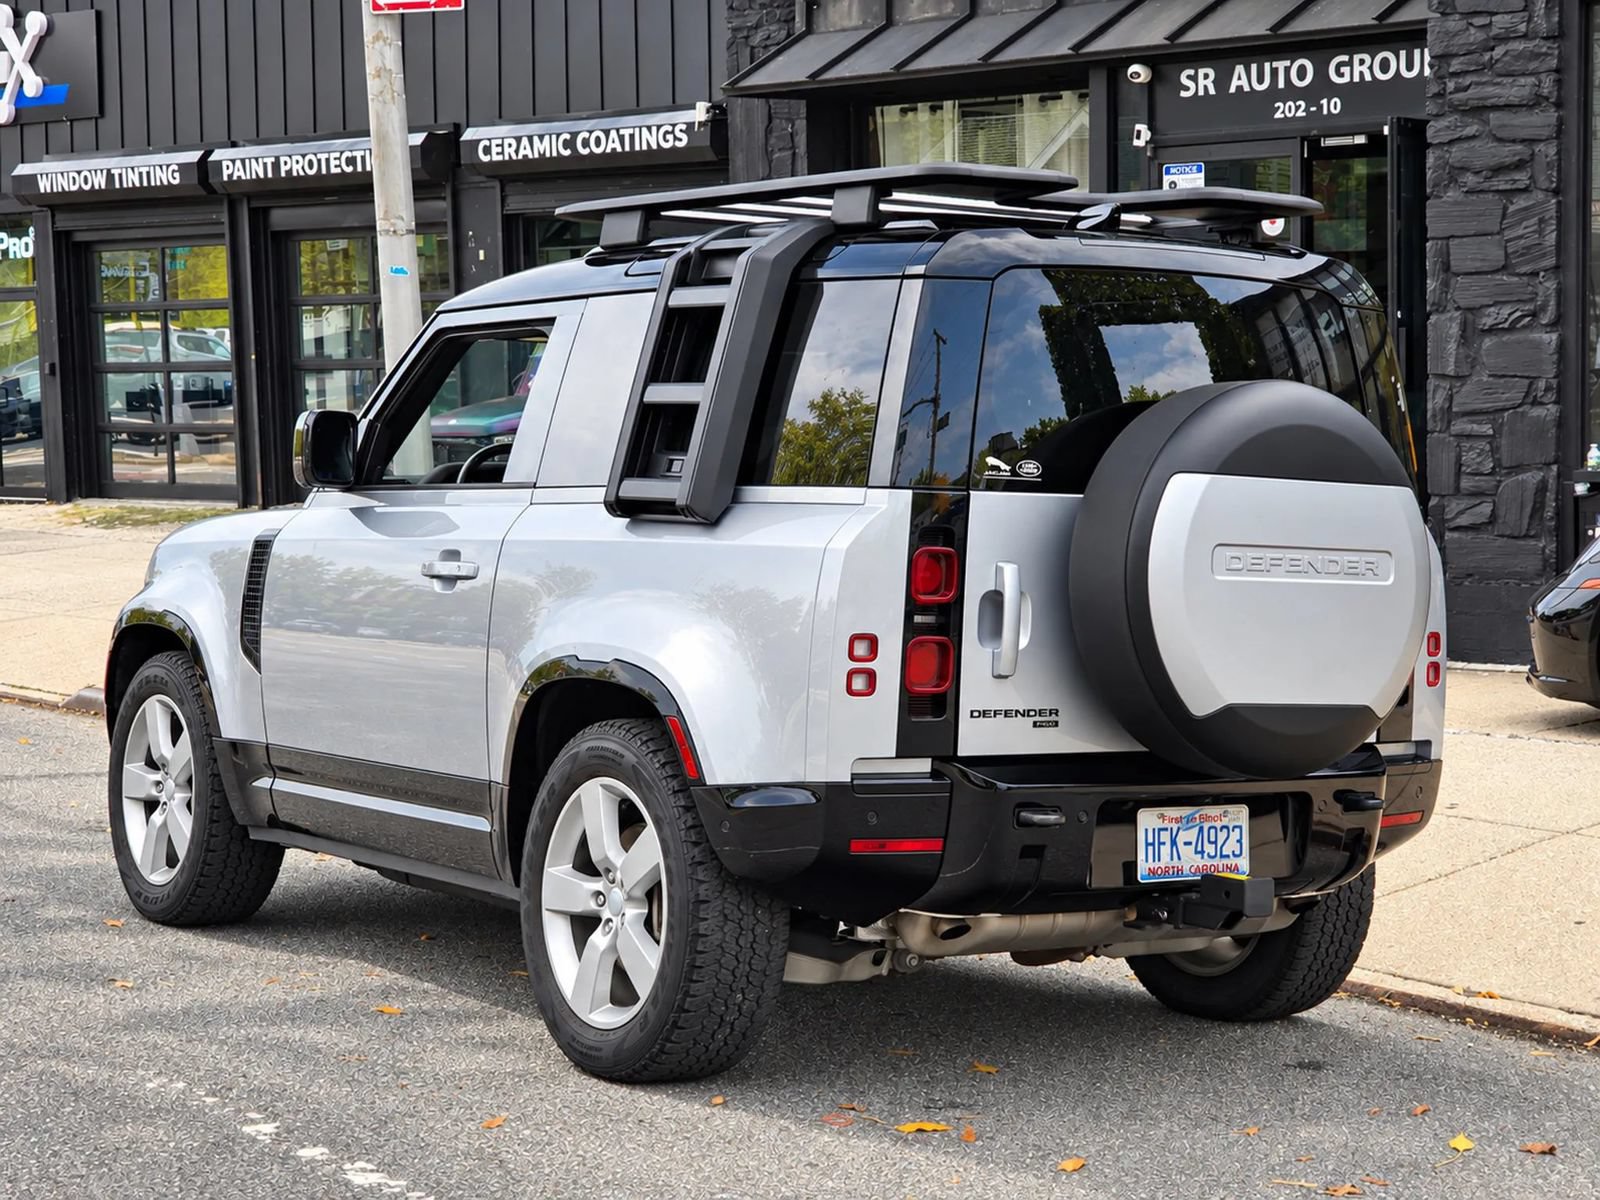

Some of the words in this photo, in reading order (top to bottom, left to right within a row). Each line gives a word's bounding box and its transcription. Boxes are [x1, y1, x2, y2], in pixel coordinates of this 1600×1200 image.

[1179, 67, 1216, 98] SR
[1228, 58, 1314, 93] AUTO
[478, 133, 571, 162] CERAMIC
[576, 124, 688, 155] COATINGS
[37, 169, 107, 193] WINDOW
[111, 164, 180, 188] TINTING
[222, 156, 275, 181] PAINT
[280, 149, 373, 177] PROTECTI
[1170, 165, 1198, 174] NOTICE
[1225, 552, 1379, 577] DEFENDER
[970, 708, 1060, 718] DEFENDER
[1145, 825, 1243, 863] HFK-4923
[1148, 865, 1184, 876] NORTH
[1189, 863, 1240, 874] CAROLINA
